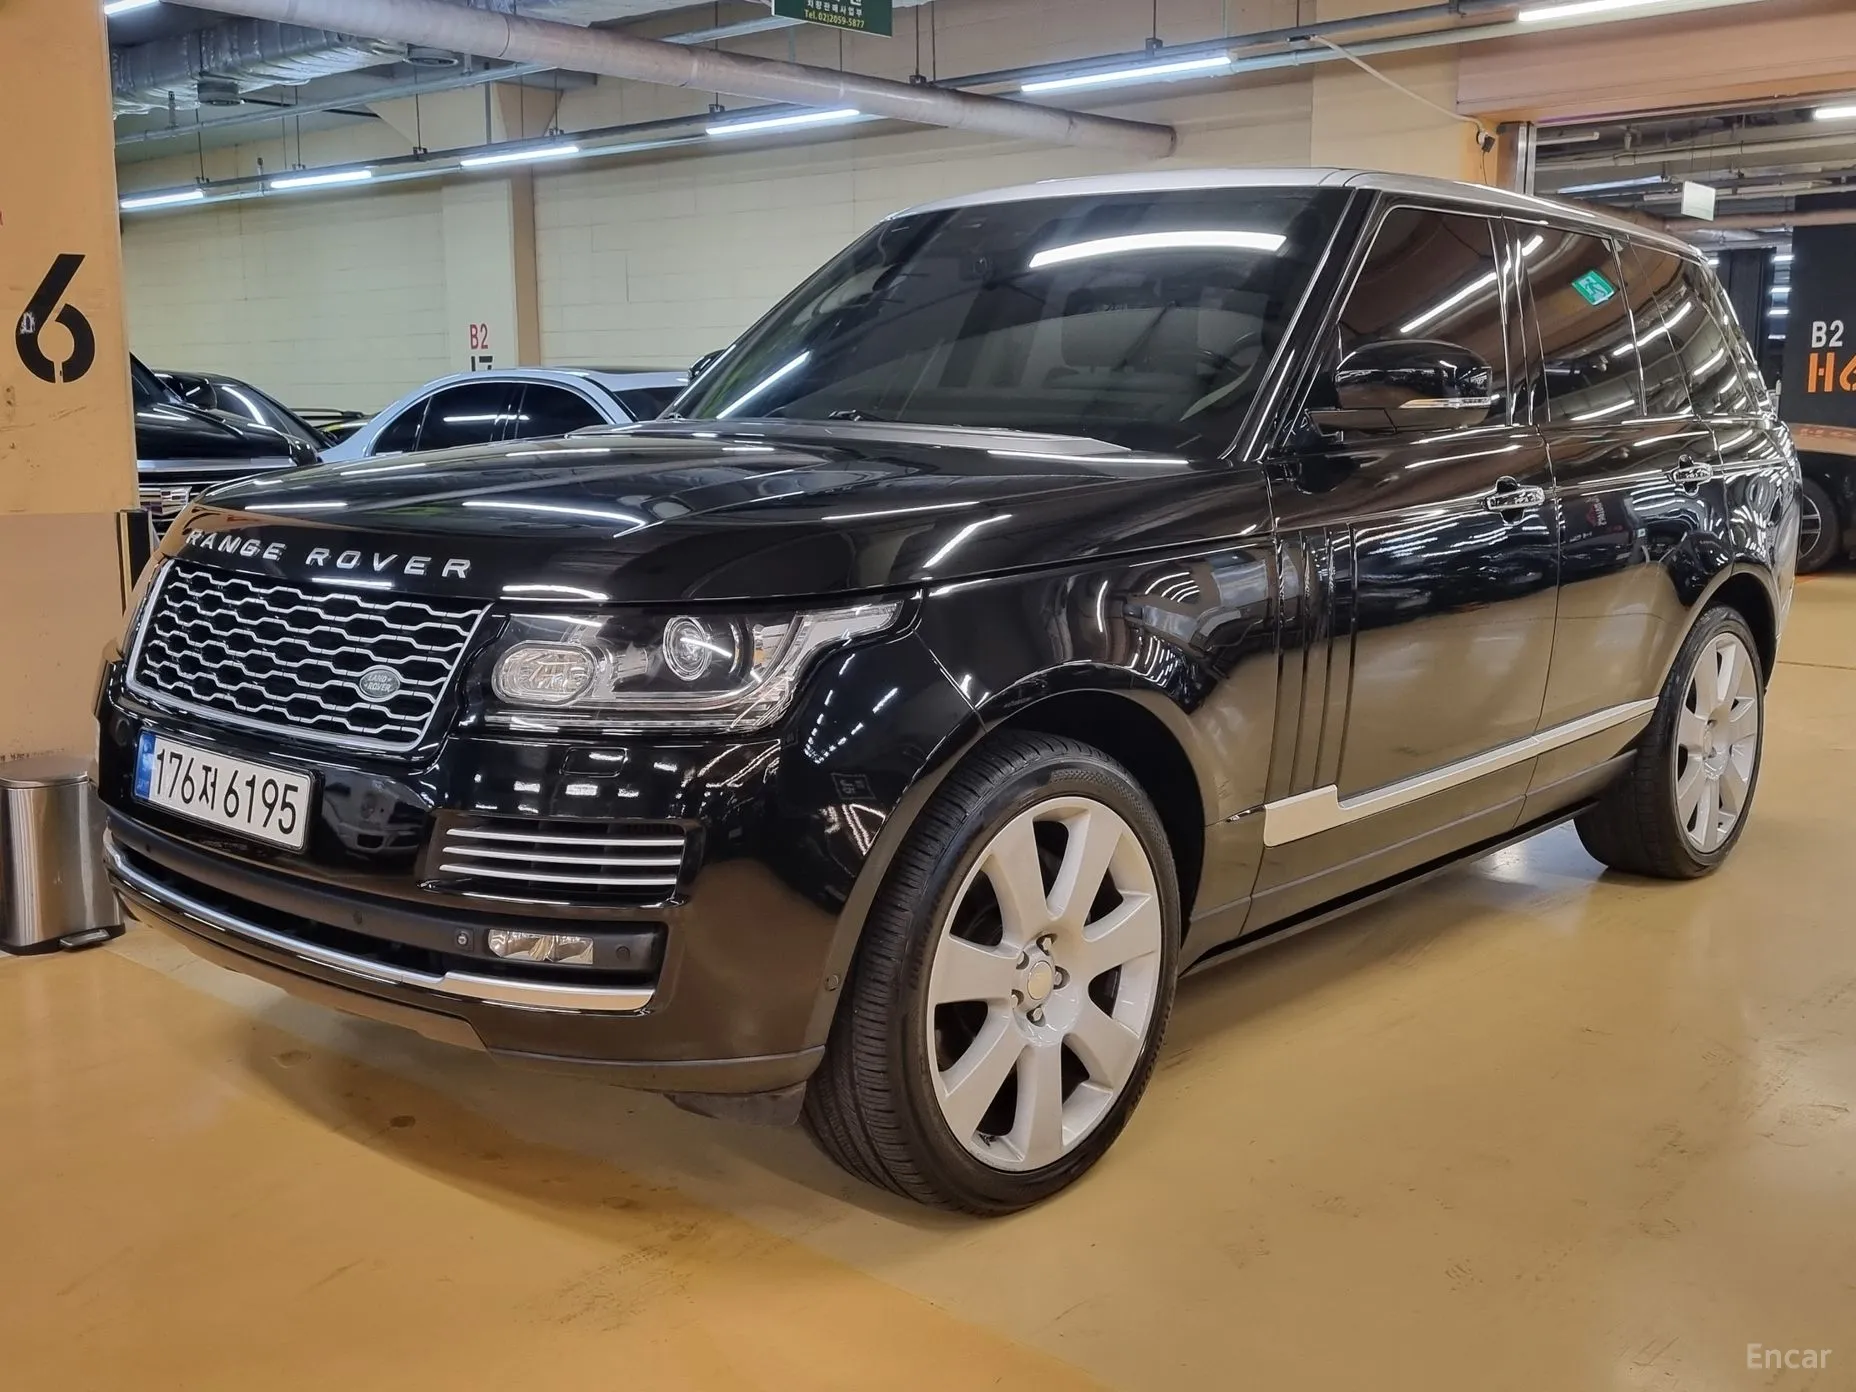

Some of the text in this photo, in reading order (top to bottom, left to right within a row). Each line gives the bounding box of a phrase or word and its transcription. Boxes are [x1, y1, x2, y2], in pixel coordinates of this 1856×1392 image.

[15, 253, 96, 384] 6
[469, 323, 489, 350] B2
[1811, 320, 1844, 348] B2
[185, 530, 471, 579] RANGE ROVER
[367, 681, 392, 693] ROVER
